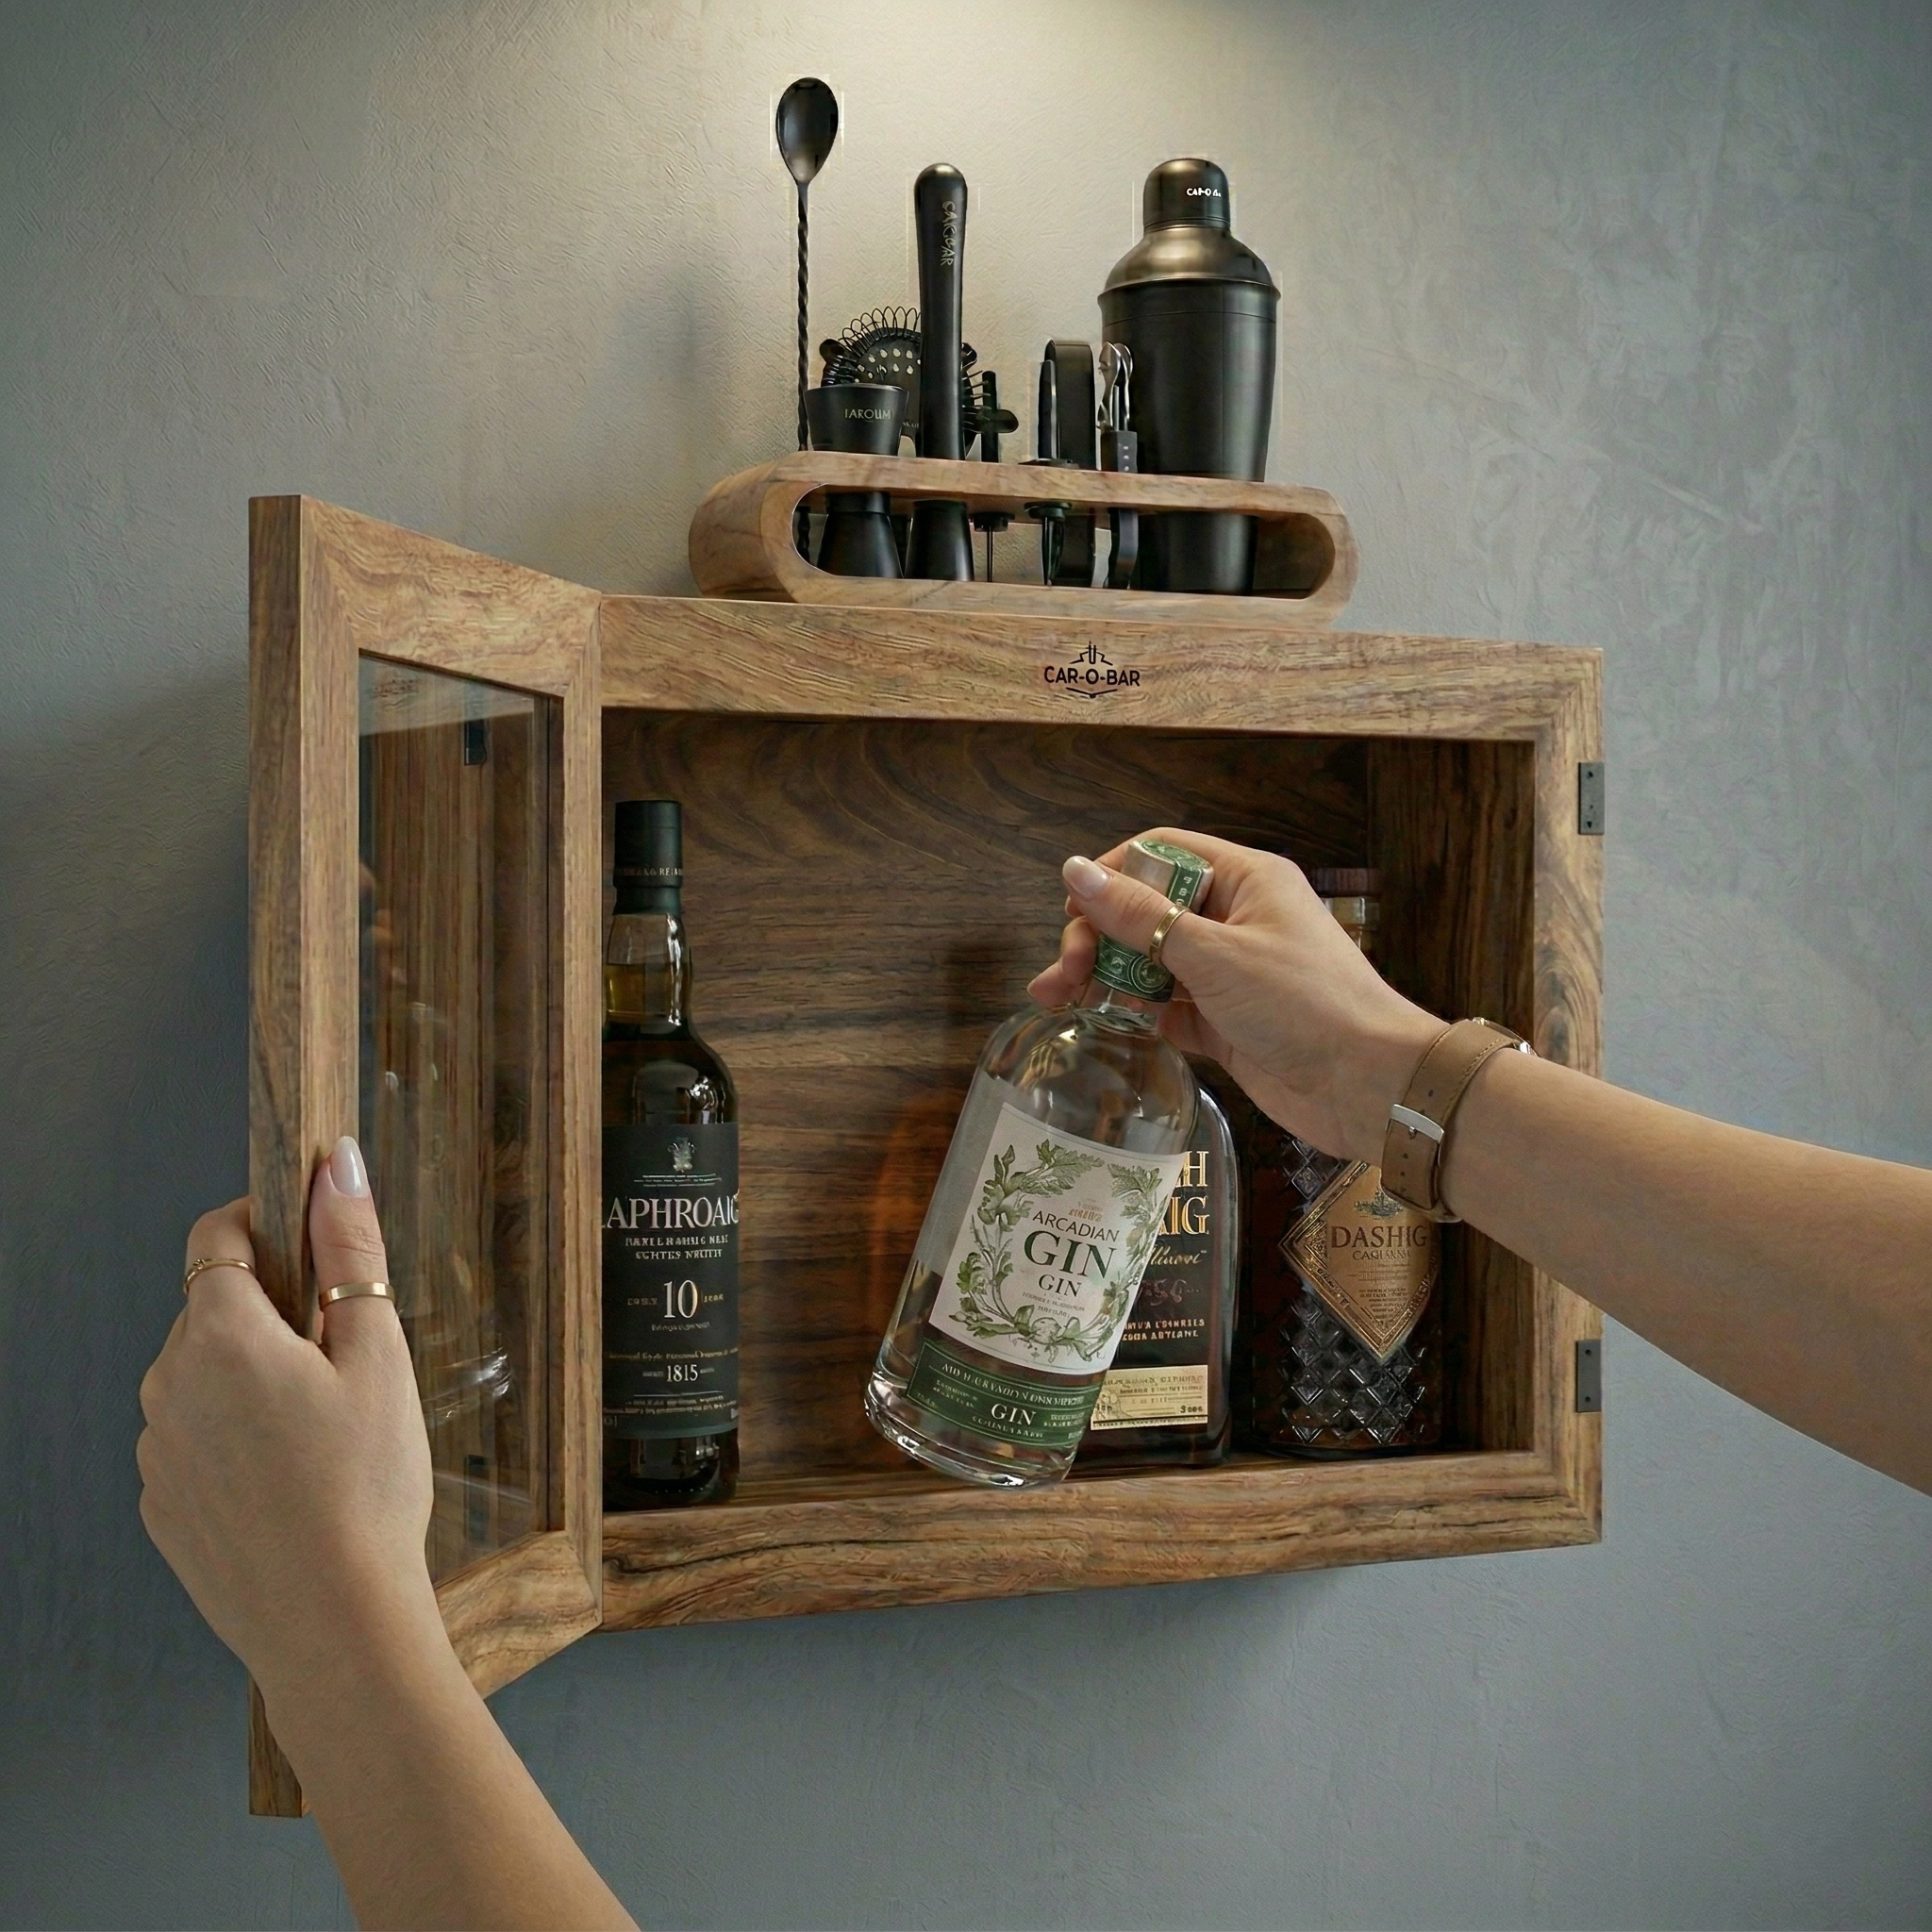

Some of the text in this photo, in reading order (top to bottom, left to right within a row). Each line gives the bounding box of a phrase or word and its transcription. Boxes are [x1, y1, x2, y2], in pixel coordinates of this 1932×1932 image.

[1043, 665, 1141, 687] CAR-O-BAR
[1032, 1210, 1120, 1242] ARCADIAN
[1024, 1230, 1117, 1279] GIN
[1038, 1274, 1082, 1297] GIN
[663, 1279, 698, 1319] 10
[666, 1364, 698, 1382] 1815
[991, 1403, 1037, 1425] GIN
